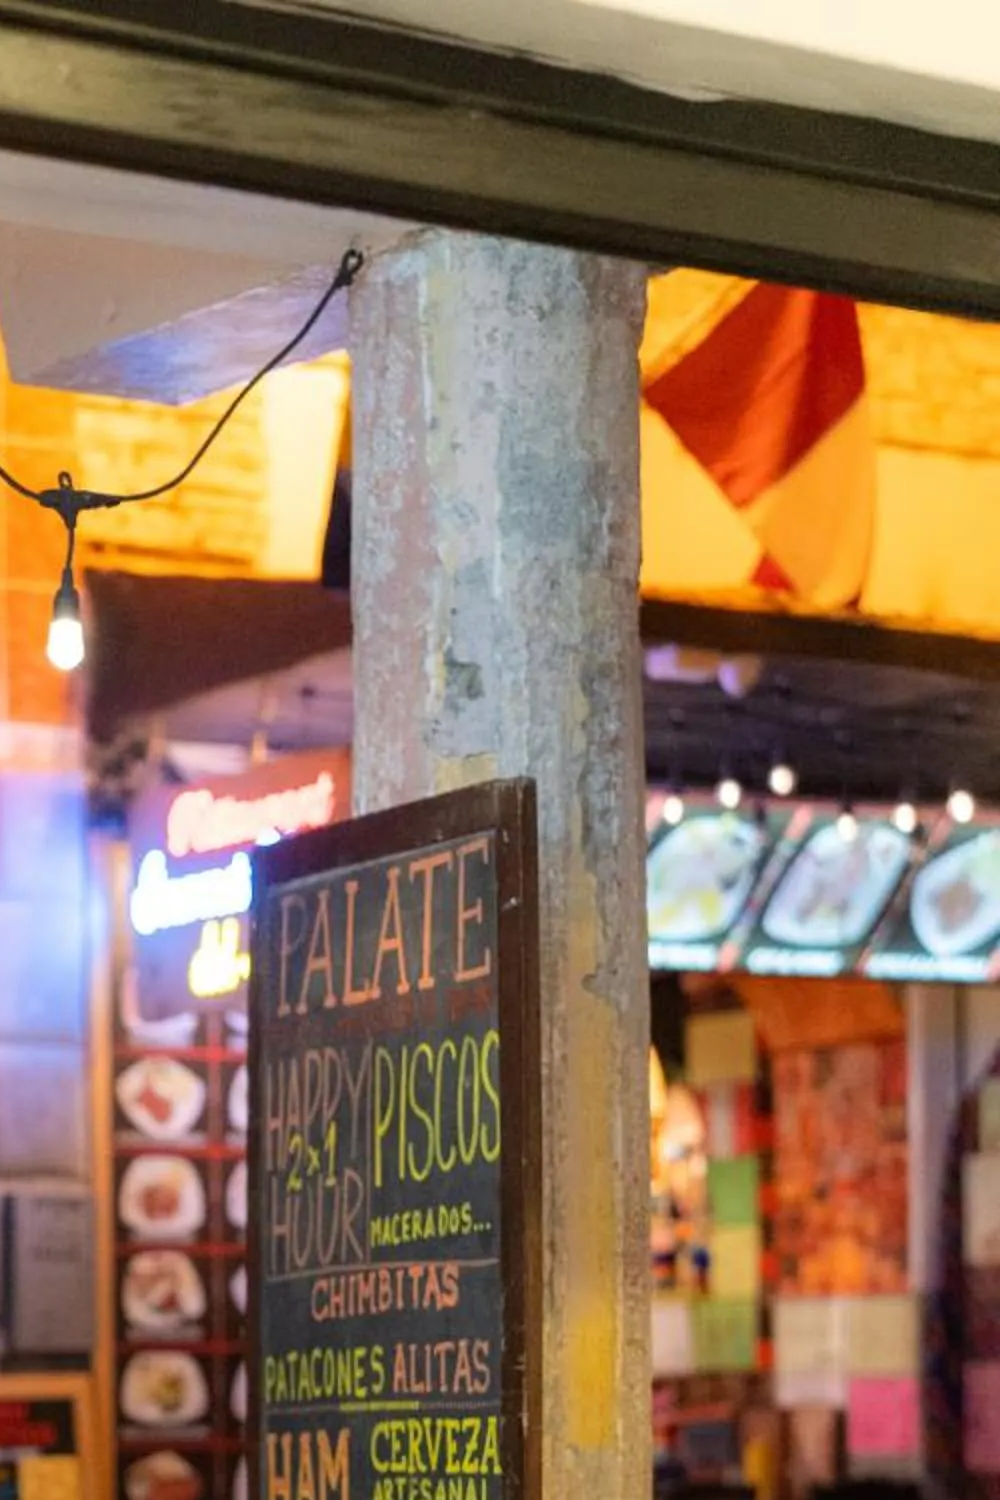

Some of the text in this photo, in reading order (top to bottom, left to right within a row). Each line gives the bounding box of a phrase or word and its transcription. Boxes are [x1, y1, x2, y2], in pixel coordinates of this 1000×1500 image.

[276, 838, 492, 1018] PALATE
[266, 1028, 501, 1188] HAPPY PISCOS
[271, 1168, 365, 1276] HOUR
[311, 1263, 461, 1321] CHIMBITAS
[265, 1339, 491, 1402] PATACONES ALITAS
[370, 1416, 502, 1475] CERVEZA
